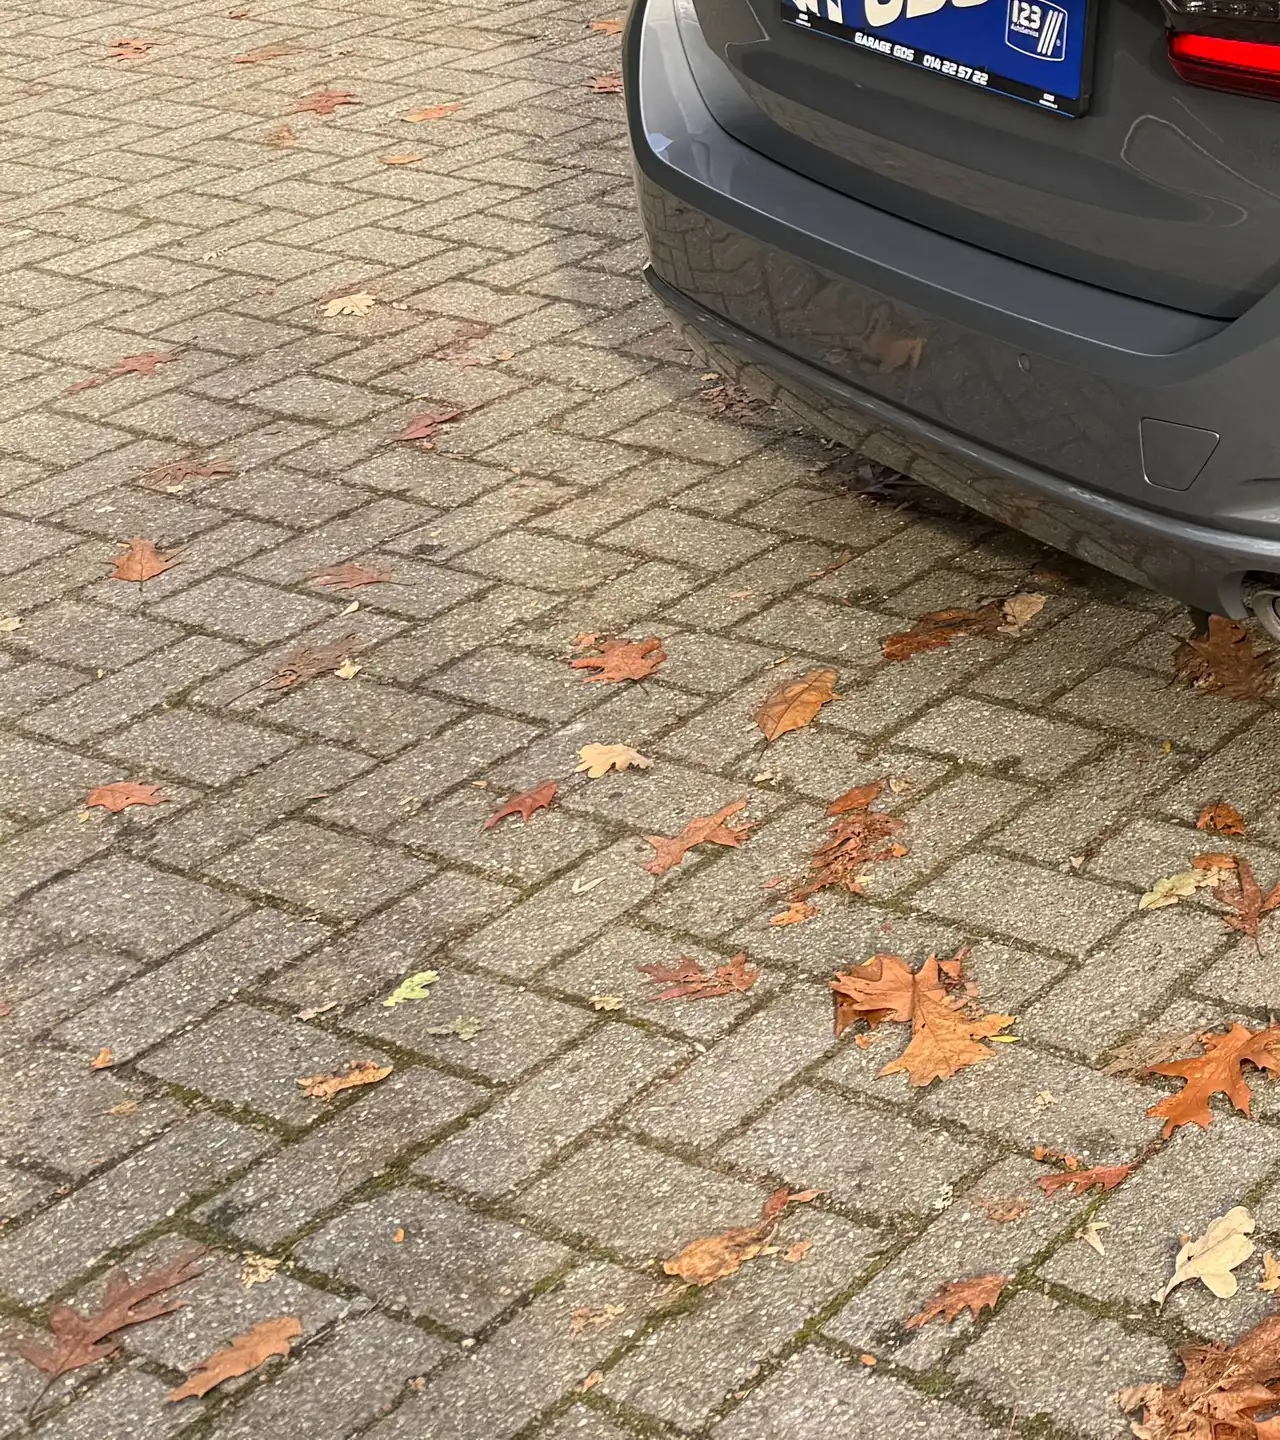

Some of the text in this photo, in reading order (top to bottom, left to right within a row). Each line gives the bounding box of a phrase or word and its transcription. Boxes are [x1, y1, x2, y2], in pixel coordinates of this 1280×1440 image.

[854, 32, 989, 85] GARAGE GDS 014 22 57 22
